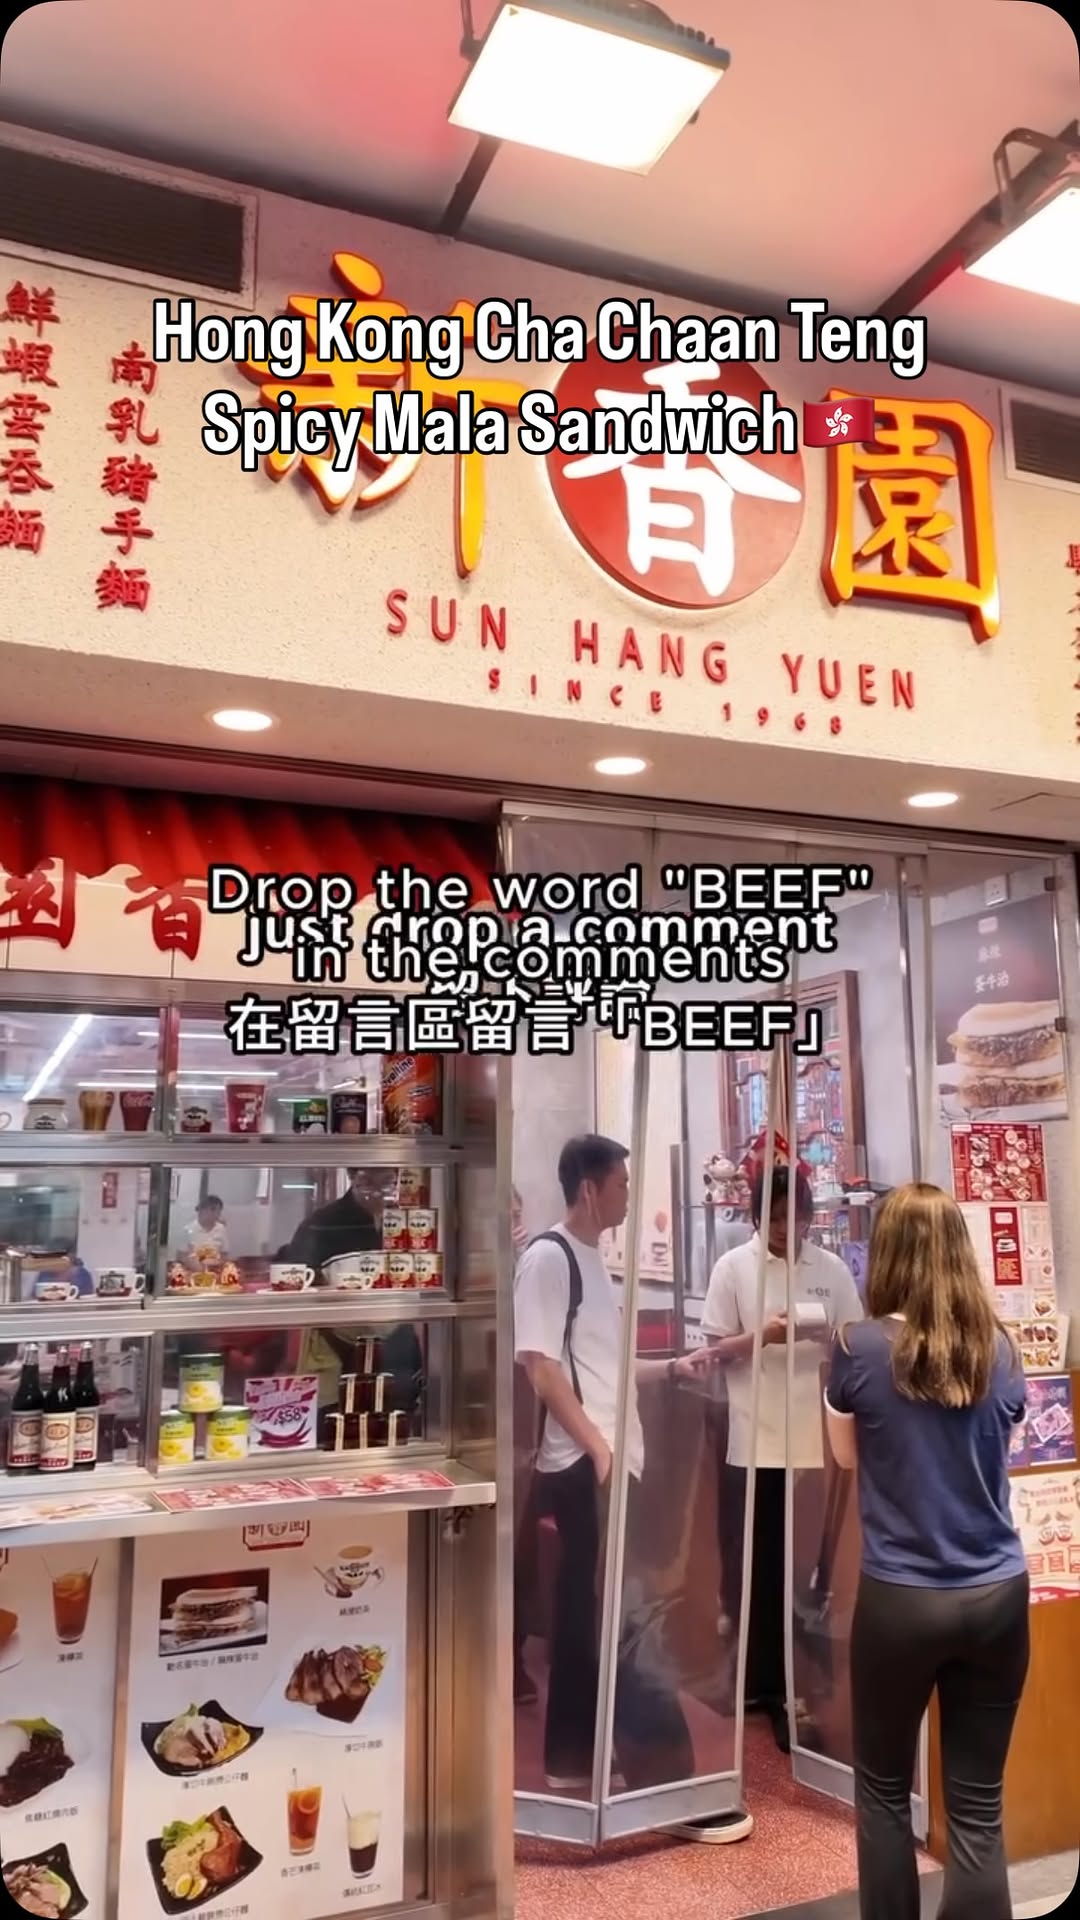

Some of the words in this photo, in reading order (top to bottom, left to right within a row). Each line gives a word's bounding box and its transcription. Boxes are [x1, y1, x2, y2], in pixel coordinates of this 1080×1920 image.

[0, 281, 58, 553] 鮮蝦雲吞麵
[96, 340, 159, 611] 南乳豬手麵
[386, 588, 507, 651] SUN
[574, 618, 728, 684] HANG
[781, 652, 916, 710] YUEN
[487, 668, 662, 713] SINCE
[722, 701, 842, 735] 1968
